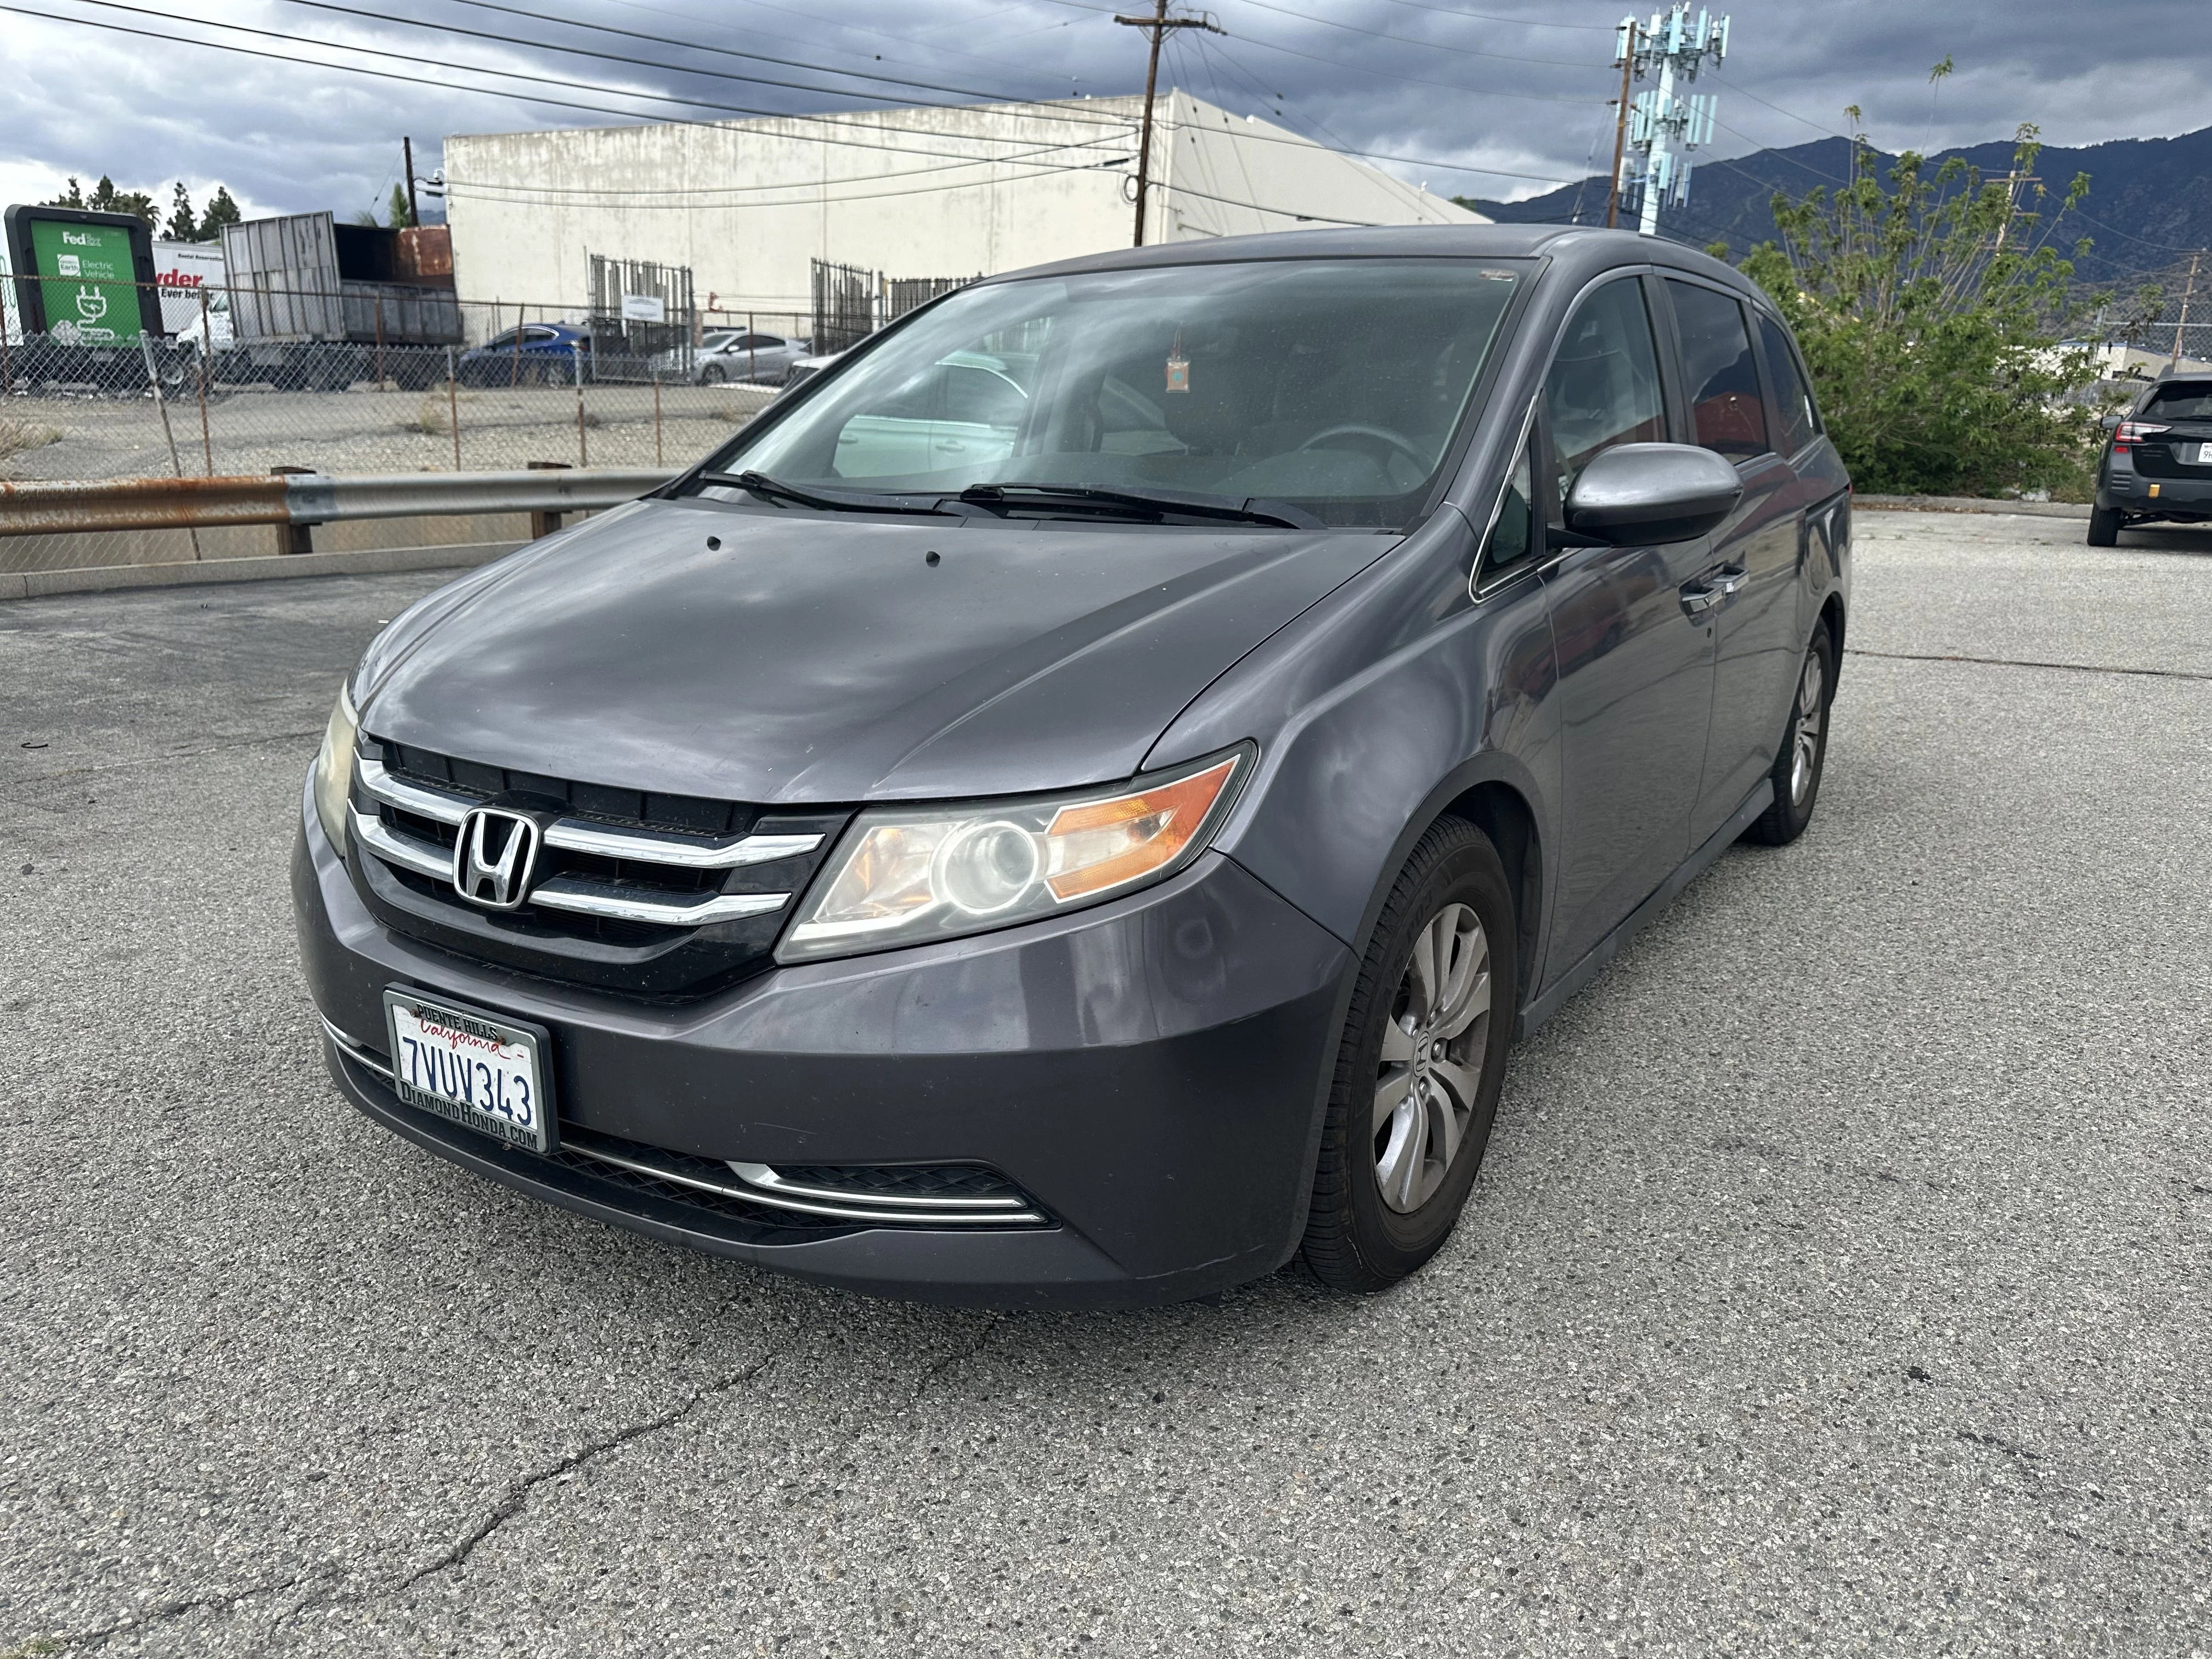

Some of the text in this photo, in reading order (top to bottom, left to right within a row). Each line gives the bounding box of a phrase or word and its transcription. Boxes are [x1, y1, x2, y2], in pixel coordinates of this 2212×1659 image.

[63, 231, 101, 247] FedEx
[82, 259, 114, 270] Electric
[83, 269, 115, 279] Vehicle
[161, 288, 182, 298] Ever
[416, 1003, 498, 1041] PUENTE HILLS
[420, 1019, 511, 1060] California
[403, 1036, 532, 1126] 7VUV343
